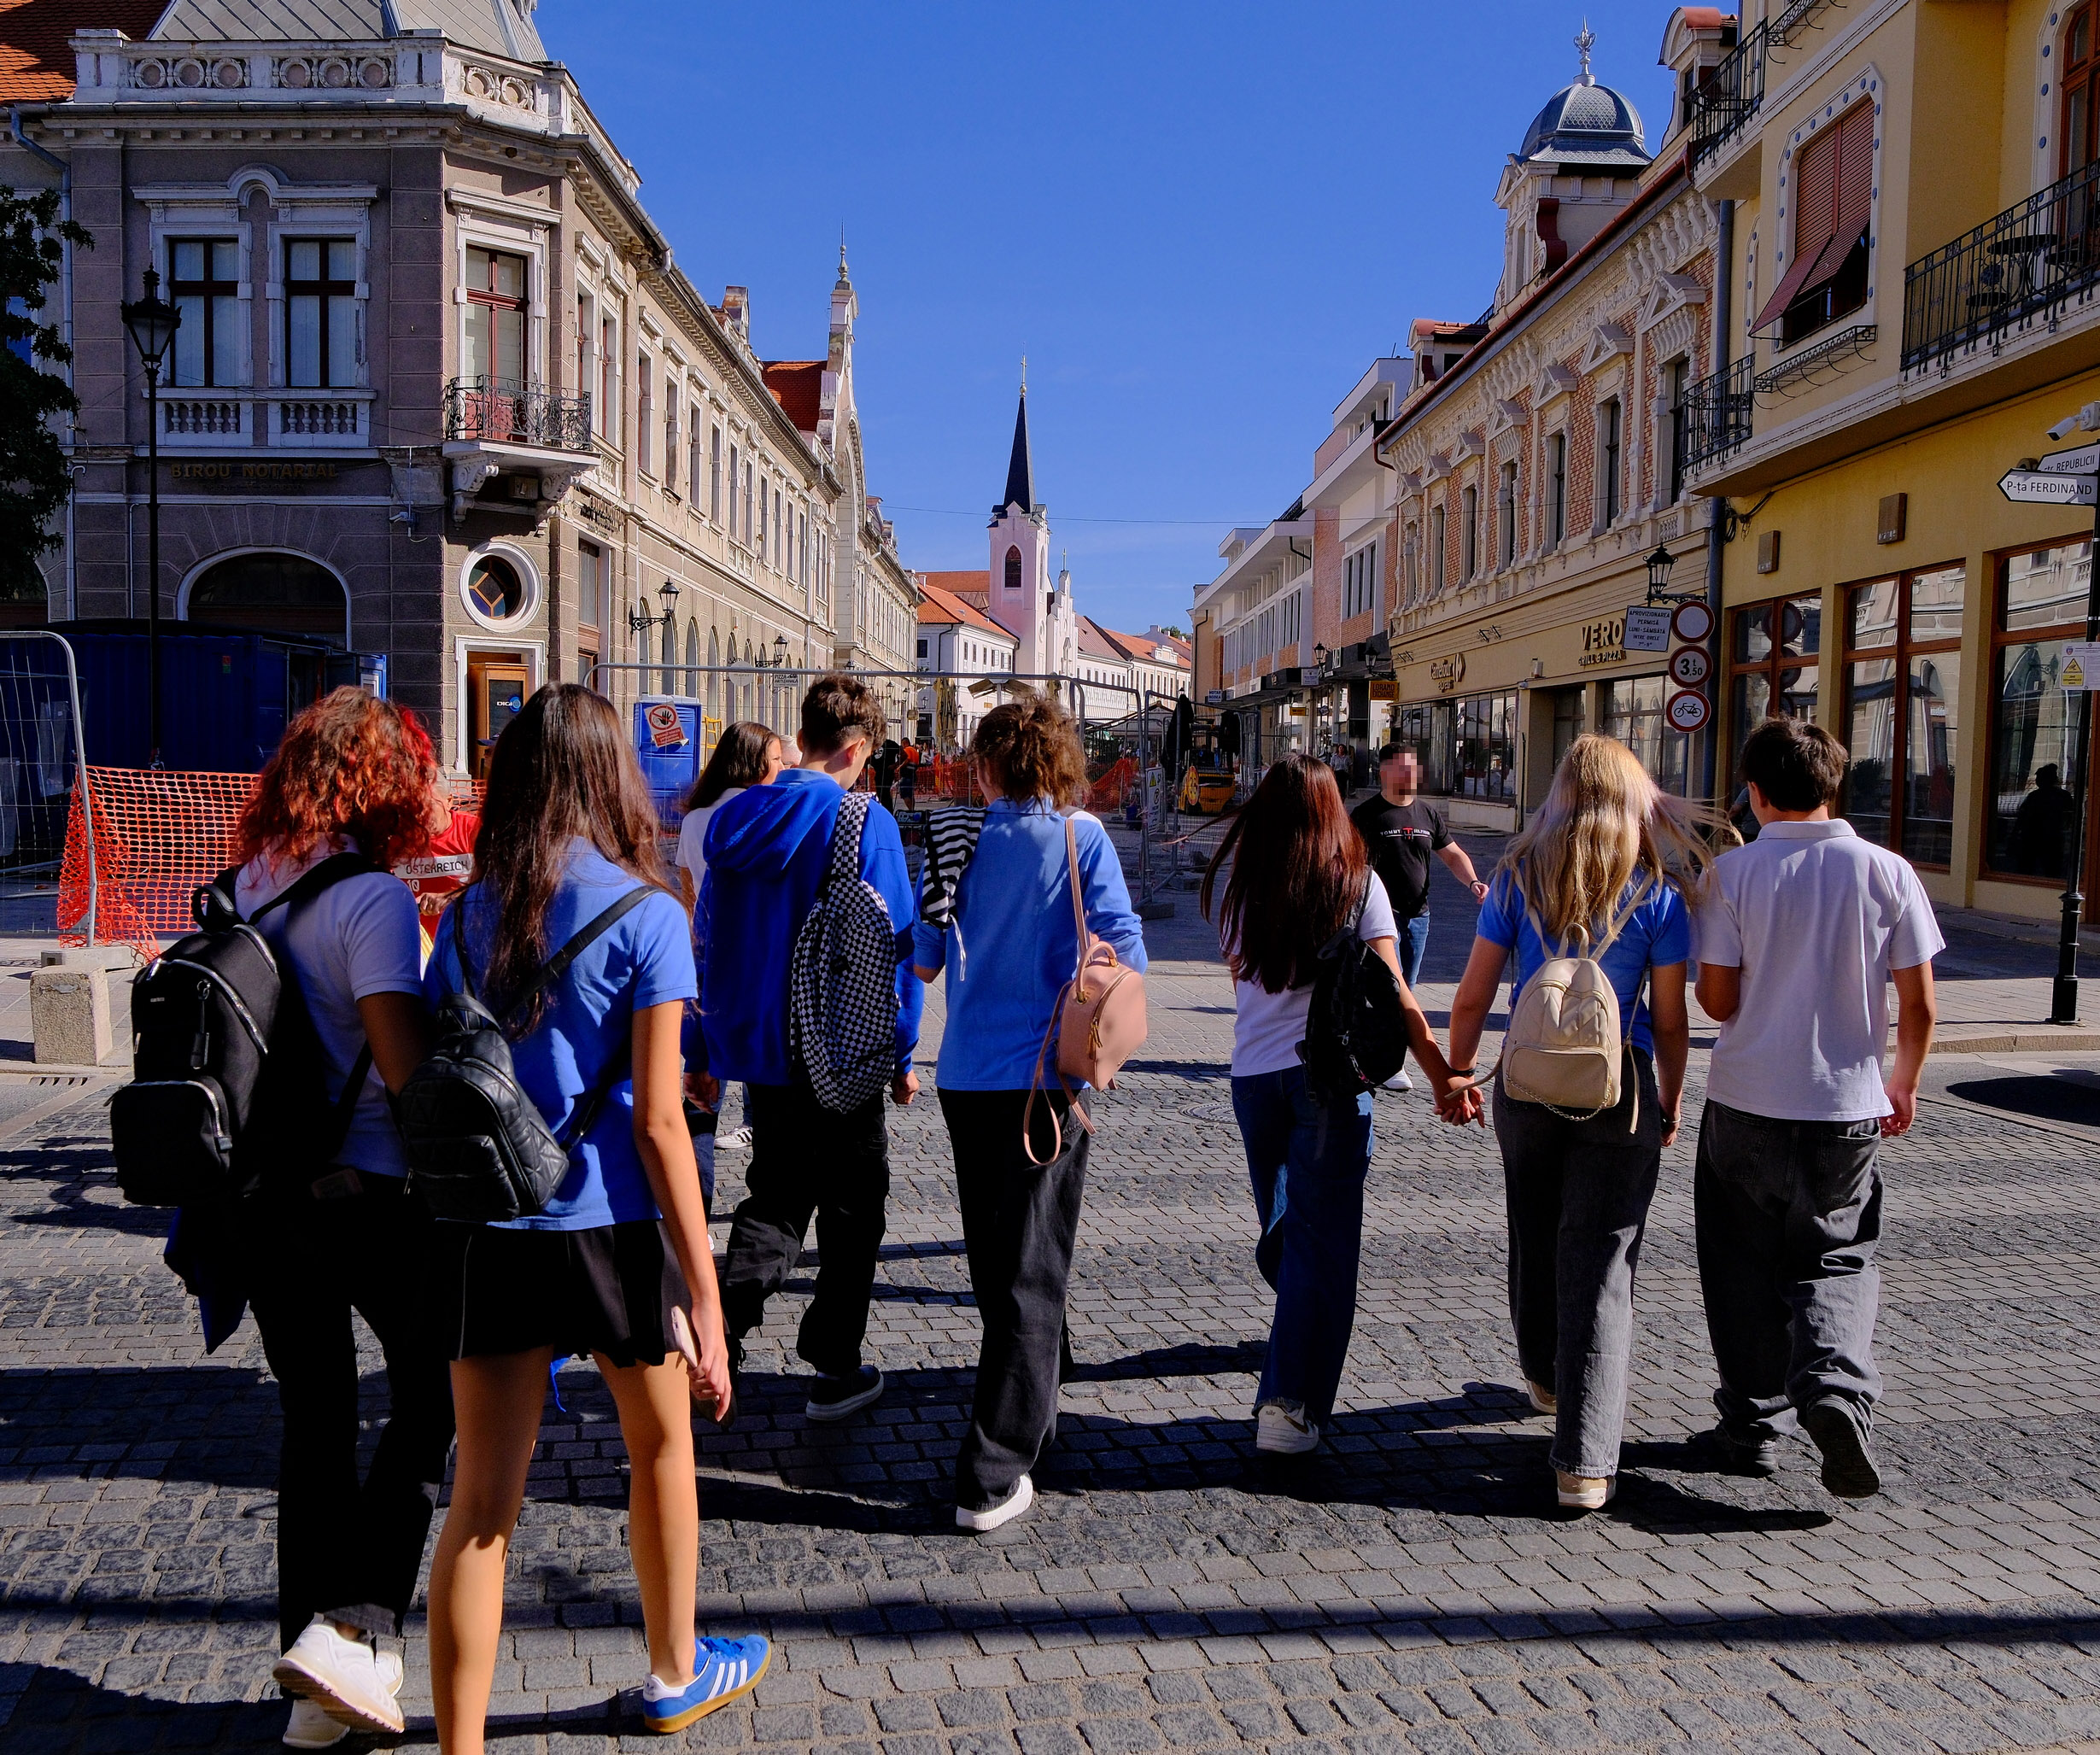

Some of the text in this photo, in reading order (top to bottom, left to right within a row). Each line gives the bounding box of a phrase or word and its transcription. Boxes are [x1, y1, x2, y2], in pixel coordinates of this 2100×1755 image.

[2056, 454, 2095, 471] REPUBLICII
[171, 464, 338, 478] BIROU NOTARIAL
[2007, 481, 2092, 494] P-ța FERDINAND
[1629, 610, 1670, 618] APROVIZIONAREA
[1581, 618, 1623, 651] VERO
[1578, 655, 1594, 666] GRILL
[1602, 650, 1622, 663] PIZZA
